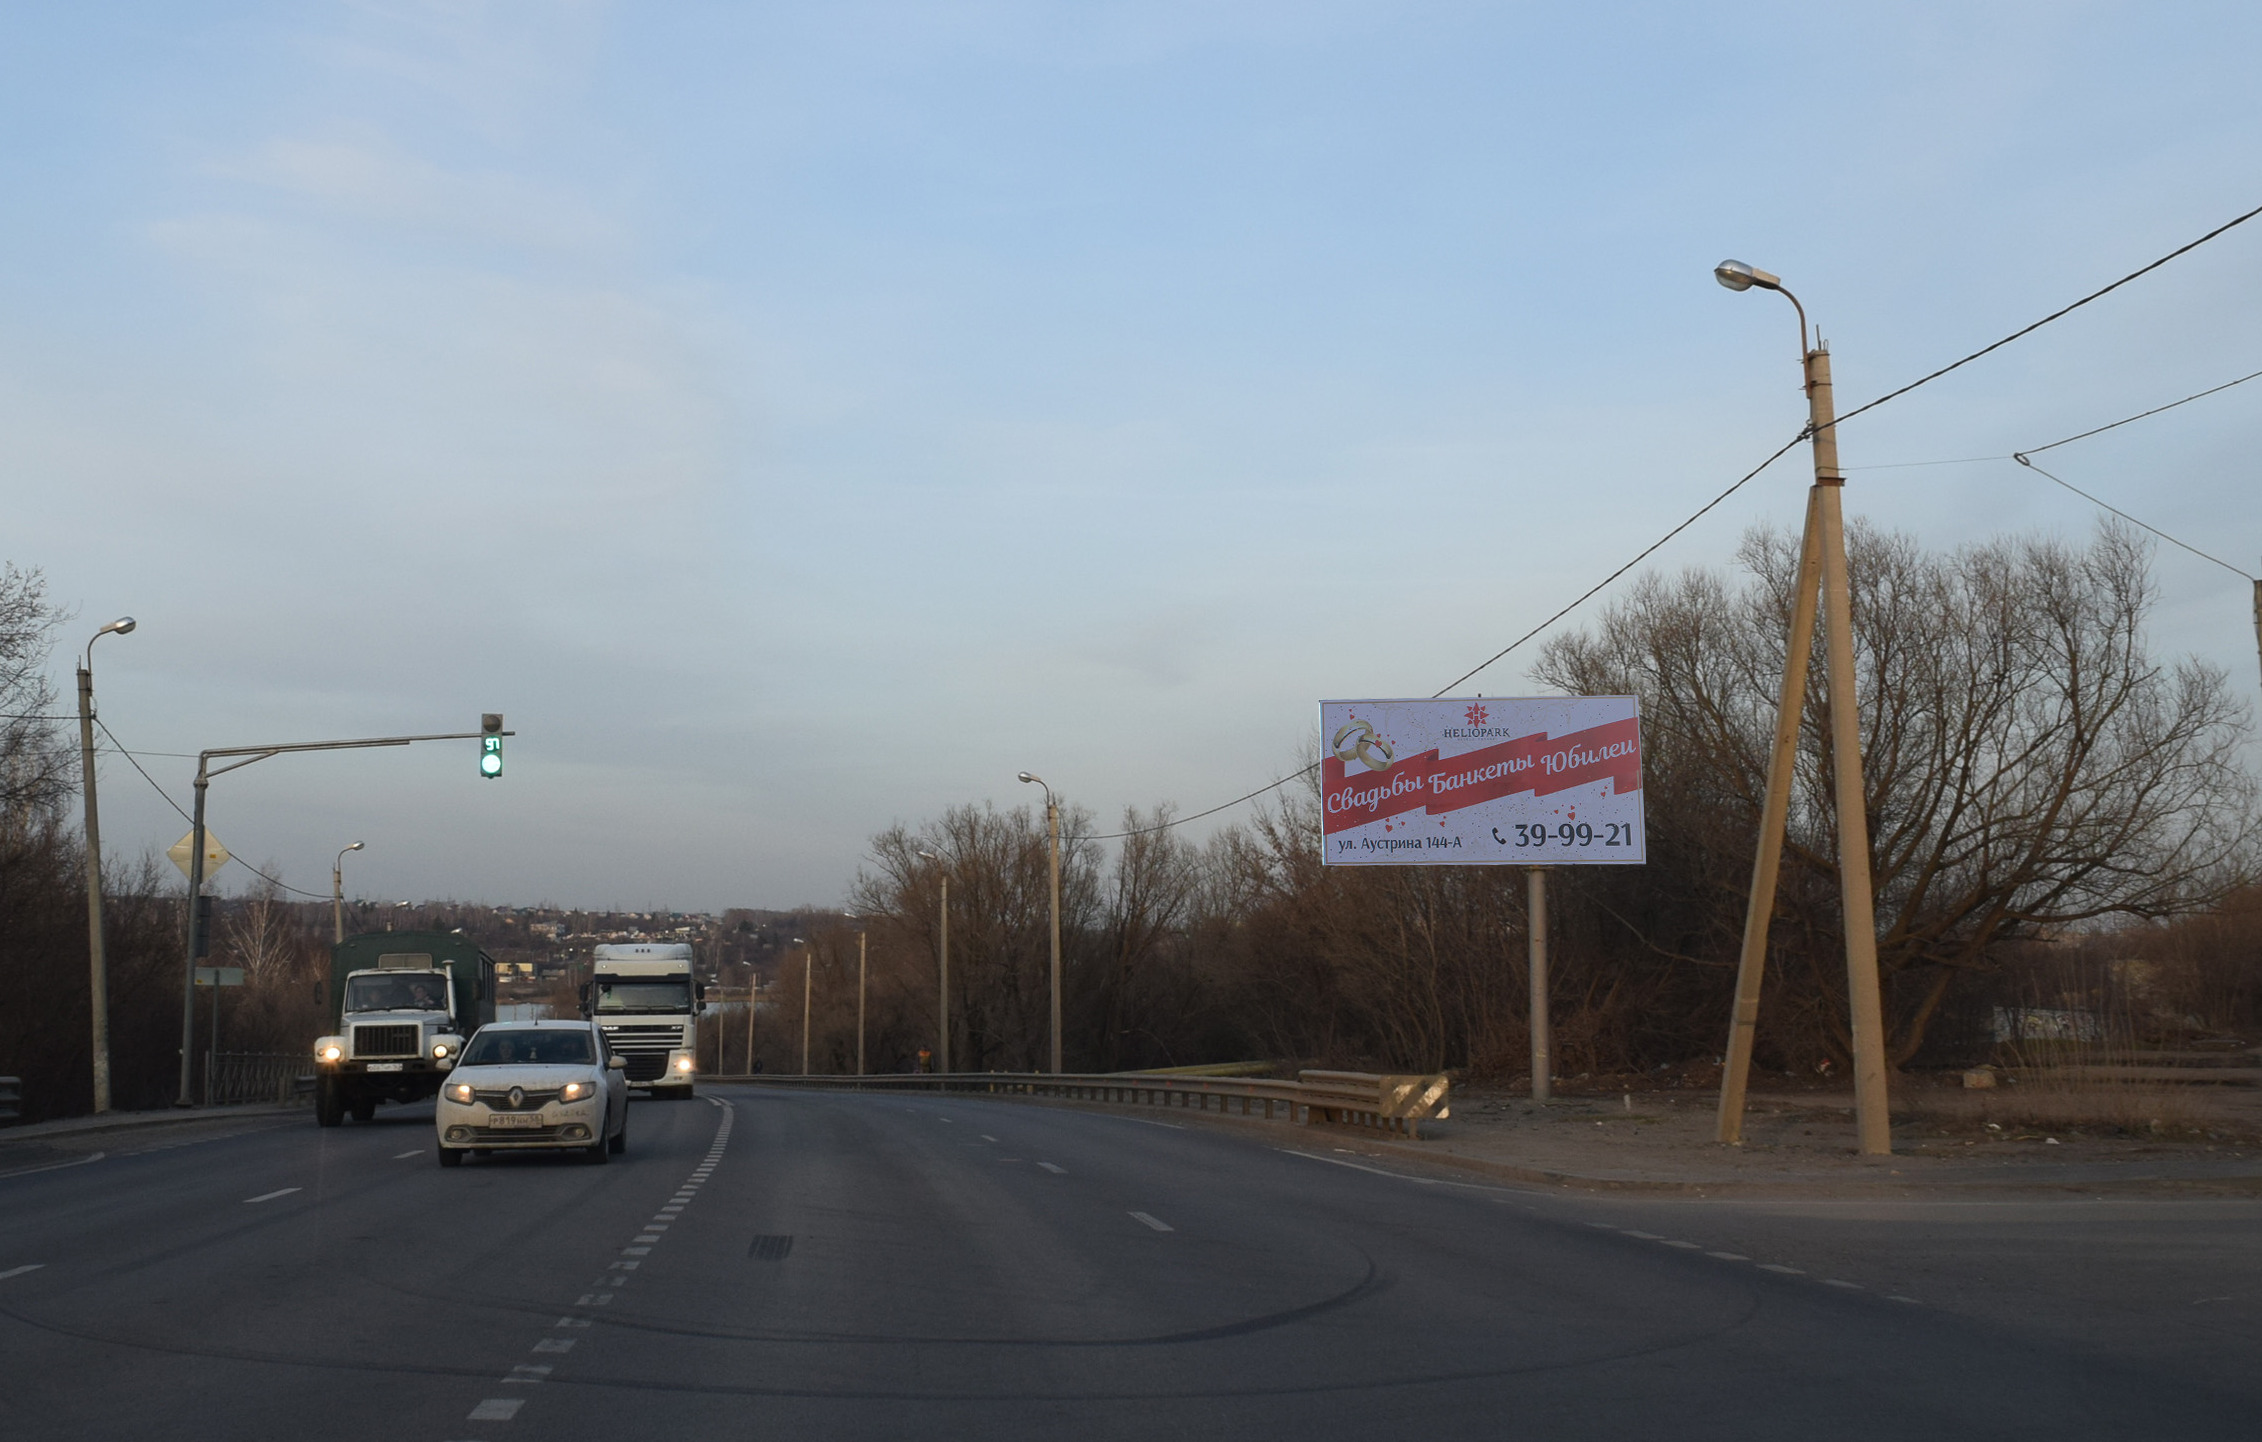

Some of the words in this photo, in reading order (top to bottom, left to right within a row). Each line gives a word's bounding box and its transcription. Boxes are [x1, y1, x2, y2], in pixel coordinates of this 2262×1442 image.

[1444, 728, 1511, 739] HELIOPARK
[1327, 771, 1424, 814] Свадьбы
[1428, 754, 1535, 794] Банкеты
[1540, 740, 1637, 775] Юбилеи
[1338, 840, 1357, 853] ул.
[1361, 838, 1423, 853] Аустрина
[1426, 836, 1462, 849] 144-А
[1515, 822, 1632, 847] 39-99-21
